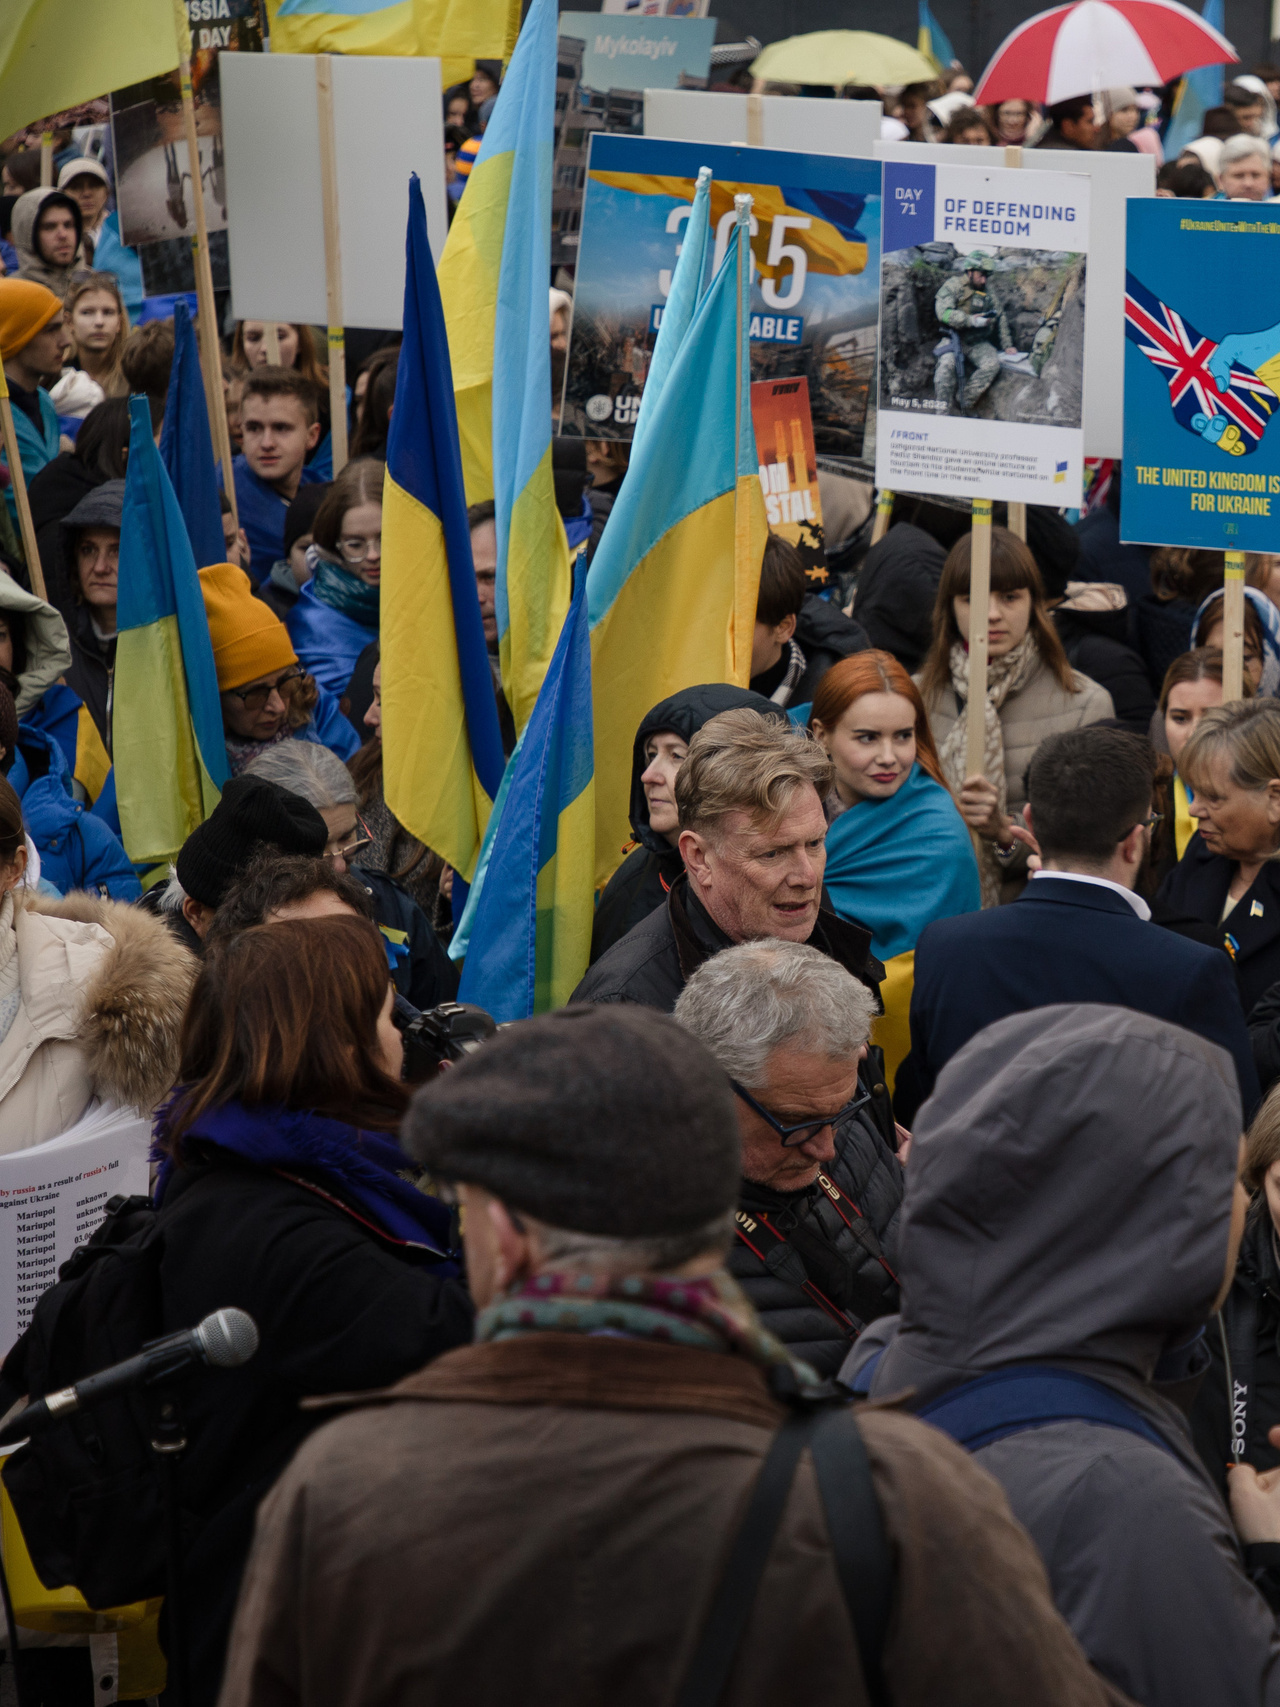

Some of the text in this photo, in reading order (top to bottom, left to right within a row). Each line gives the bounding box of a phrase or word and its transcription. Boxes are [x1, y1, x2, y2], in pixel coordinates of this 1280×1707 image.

[186, 0, 231, 21] SSIA
[199, 25, 231, 49] DAY
[593, 34, 679, 60] Mykolayiv
[895, 187, 923, 201] DAY
[900, 203, 917, 215] 71
[944, 198, 1076, 222] OF DEFENDING
[944, 216, 1031, 236] FREEDOM
[891, 396, 911, 409] May
[1135, 466, 1160, 485] THE
[1162, 468, 1207, 488] UNITED
[1209, 471, 1267, 492] KINGDOM
[1268, 475, 1280, 494] IS
[1190, 493, 1272, 516] FOR UKRAINE
[0, 1189, 10, 1197] by
[12, 1186, 36, 1195] russia
[53, 1176, 74, 1188] result
[74, 1173, 83, 1181] of
[108, 1160, 119, 1170] full
[0, 1191, 60, 1209] against Ukraine
[16, 1191, 108, 1221] Mariupol unknown
[16, 1219, 56, 1233] Mariupol
[16, 1231, 56, 1245] Mariupol
[16, 1242, 56, 1257] Mariupol
[16, 1255, 56, 1269] Mariupol
[16, 1267, 56, 1281] Mariupol
[1231, 1379, 1248, 1455] SONY
